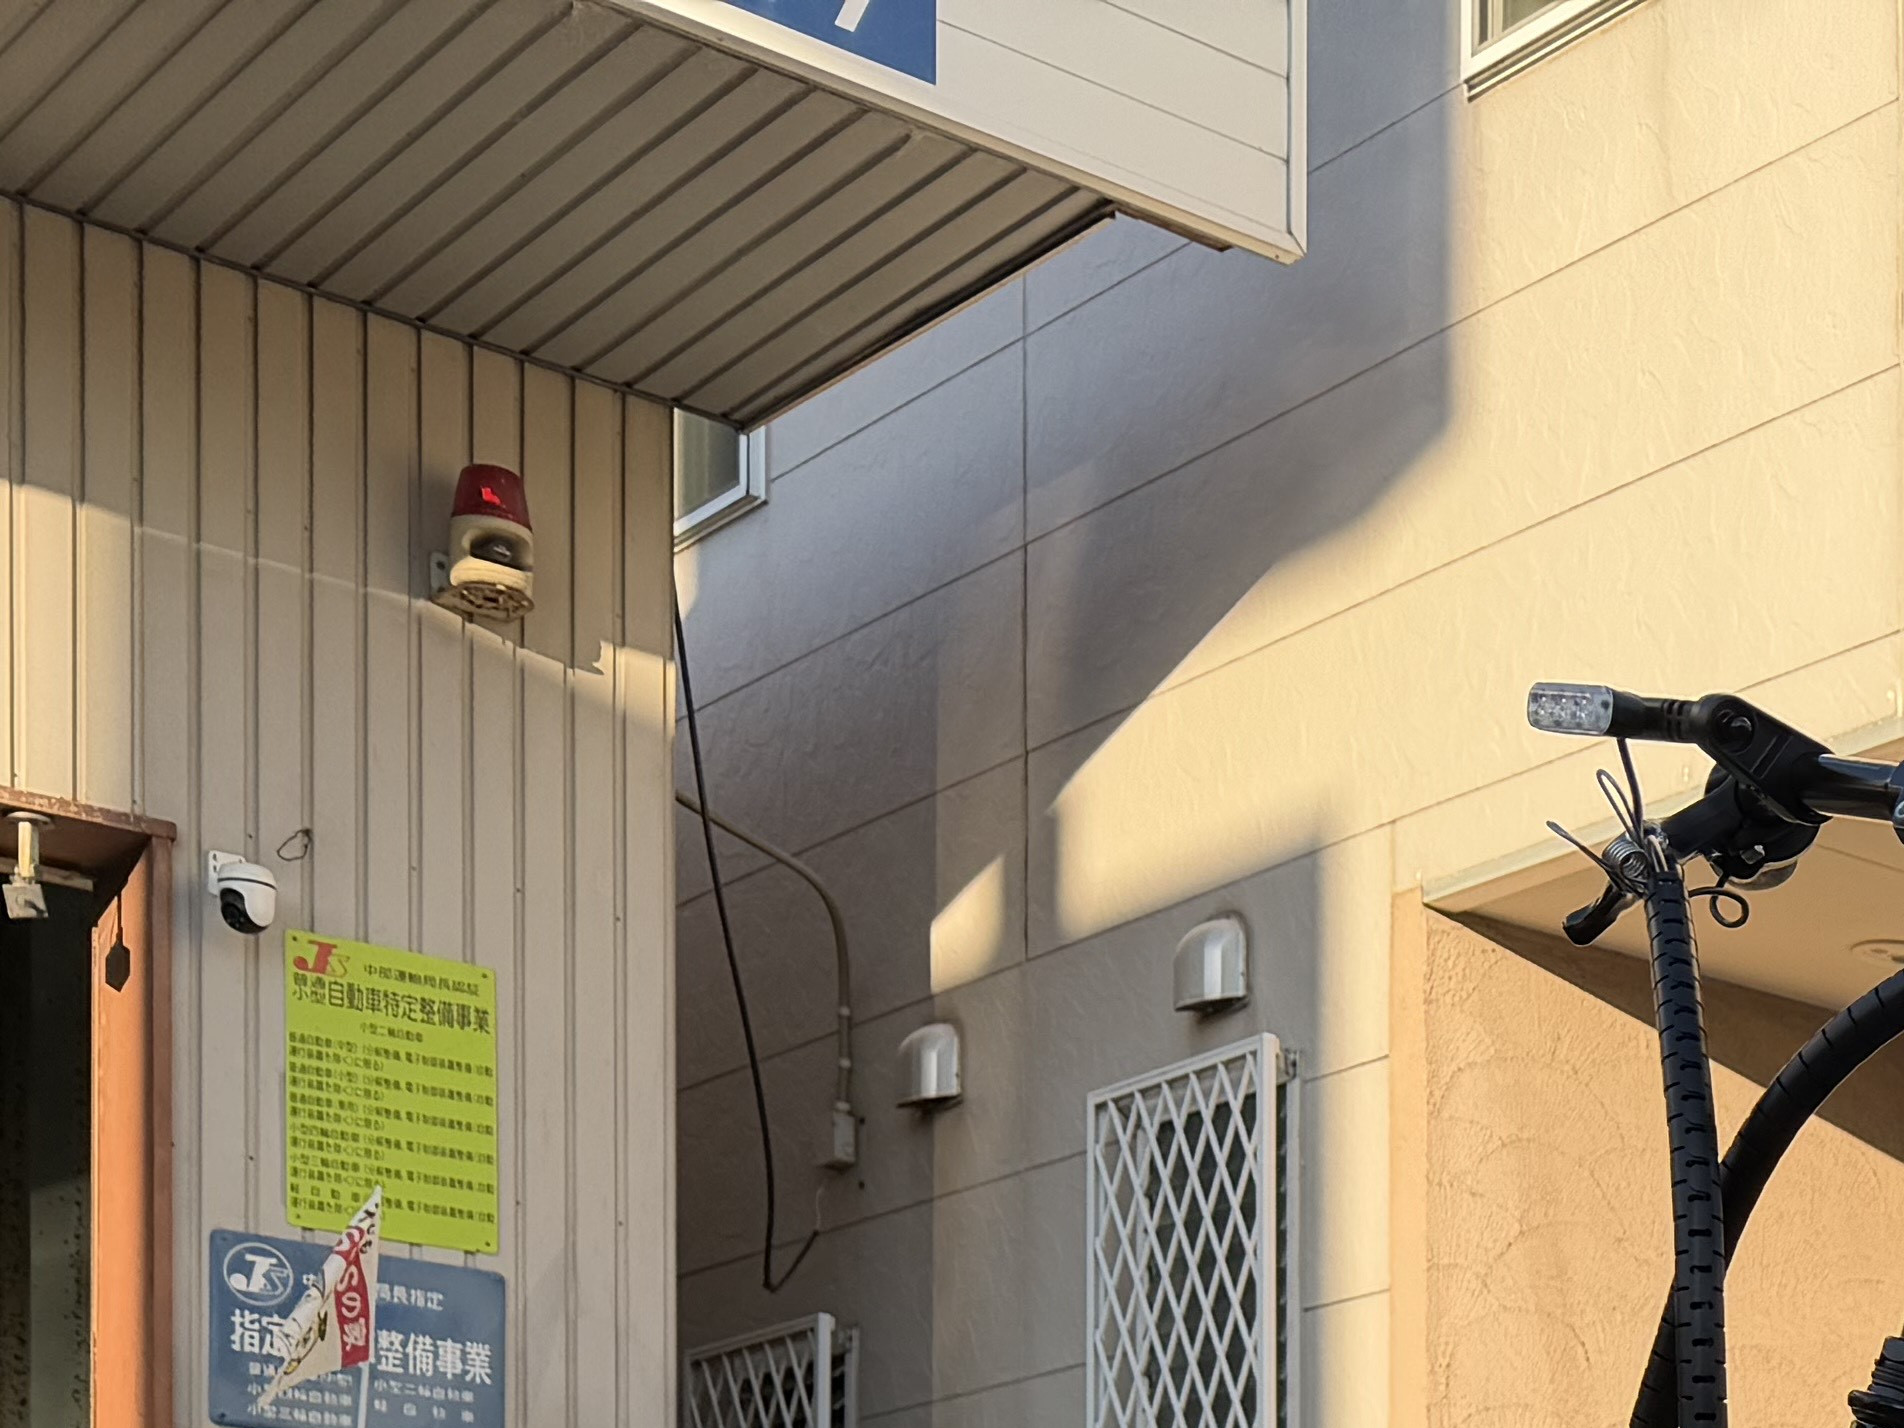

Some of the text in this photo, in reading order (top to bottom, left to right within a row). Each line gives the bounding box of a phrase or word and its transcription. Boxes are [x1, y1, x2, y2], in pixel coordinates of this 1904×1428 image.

[328, 980, 491, 1035] 自動車特定整備事業
[230, 1308, 493, 1386] 指定整備事業
